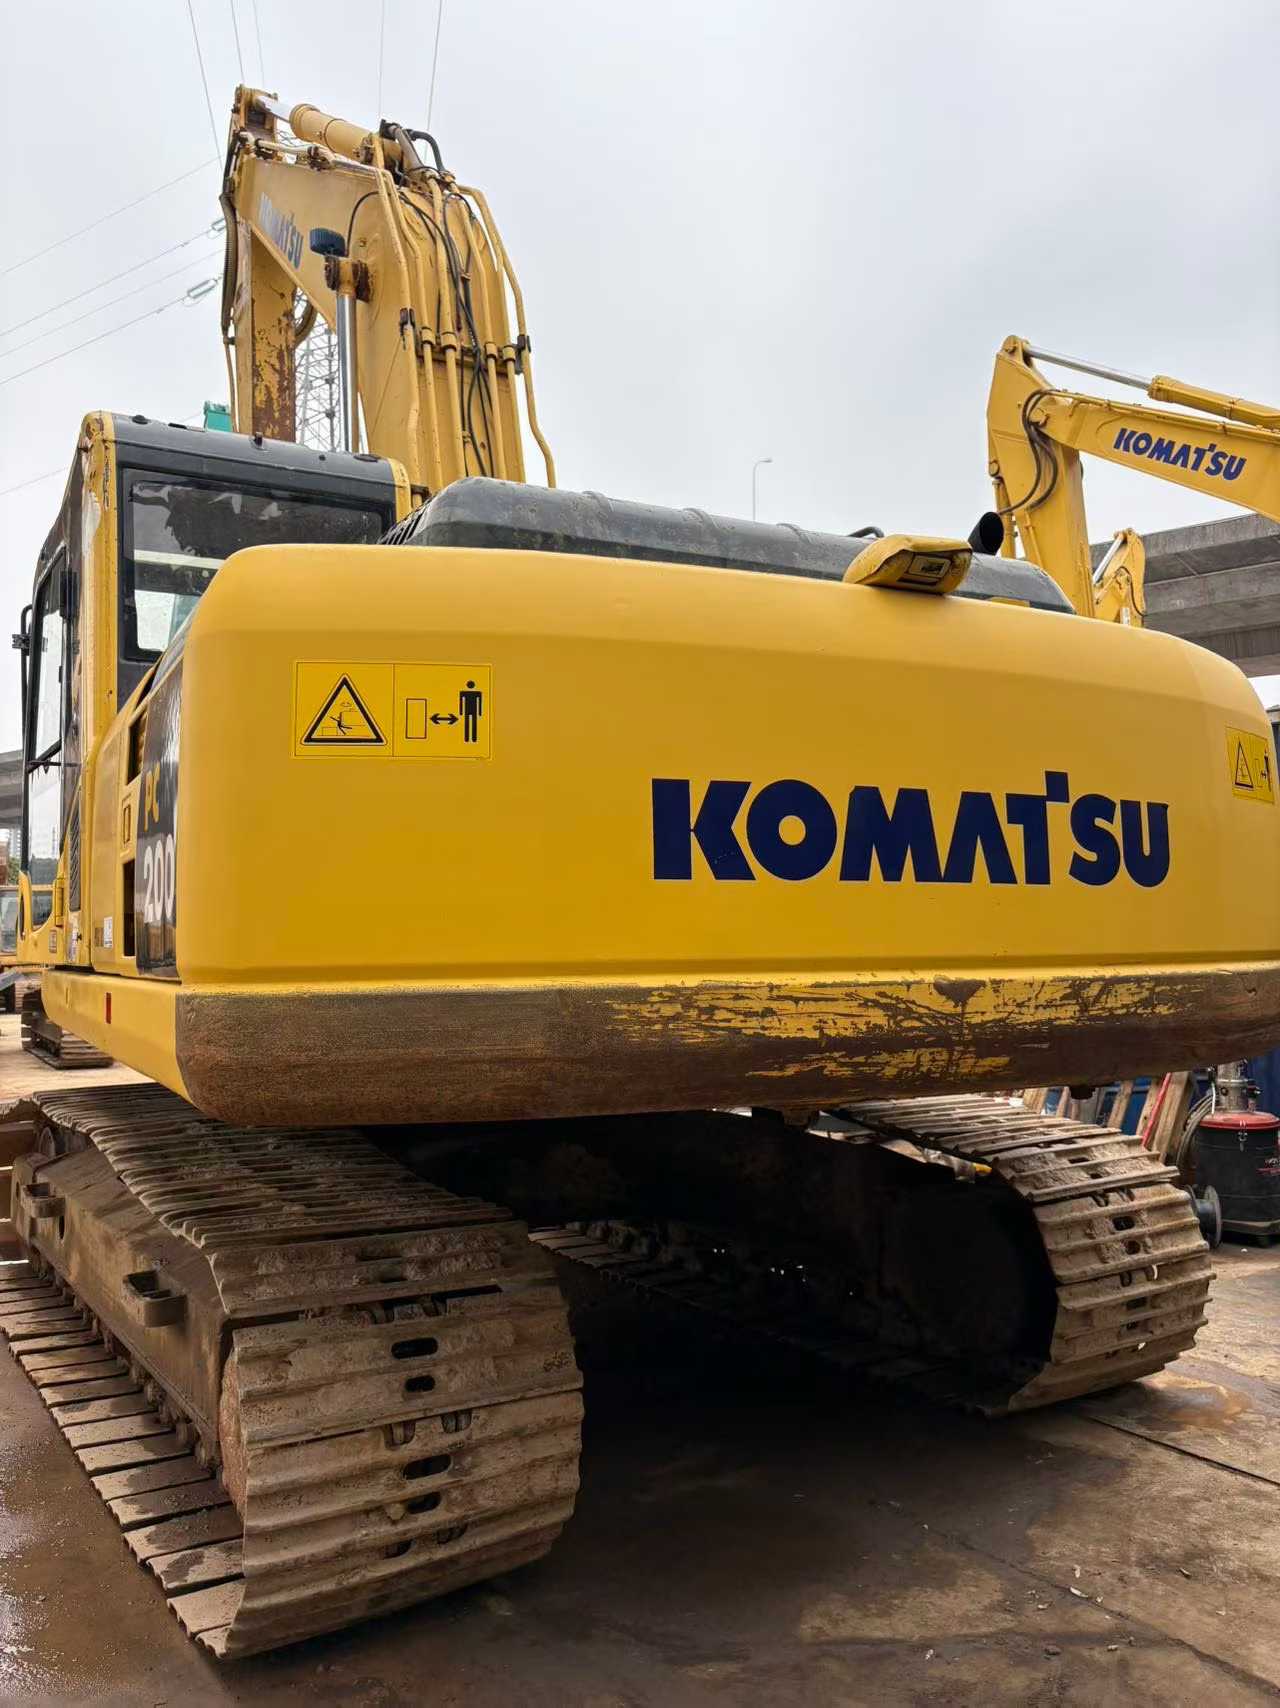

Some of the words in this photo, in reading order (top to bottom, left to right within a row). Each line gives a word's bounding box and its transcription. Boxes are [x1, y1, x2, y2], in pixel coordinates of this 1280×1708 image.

[1113, 427, 1247, 481] KOMATSU
[144, 761, 161, 832] PC
[652, 770, 1170, 888] KOMATSU
[143, 834, 175, 923] 200
